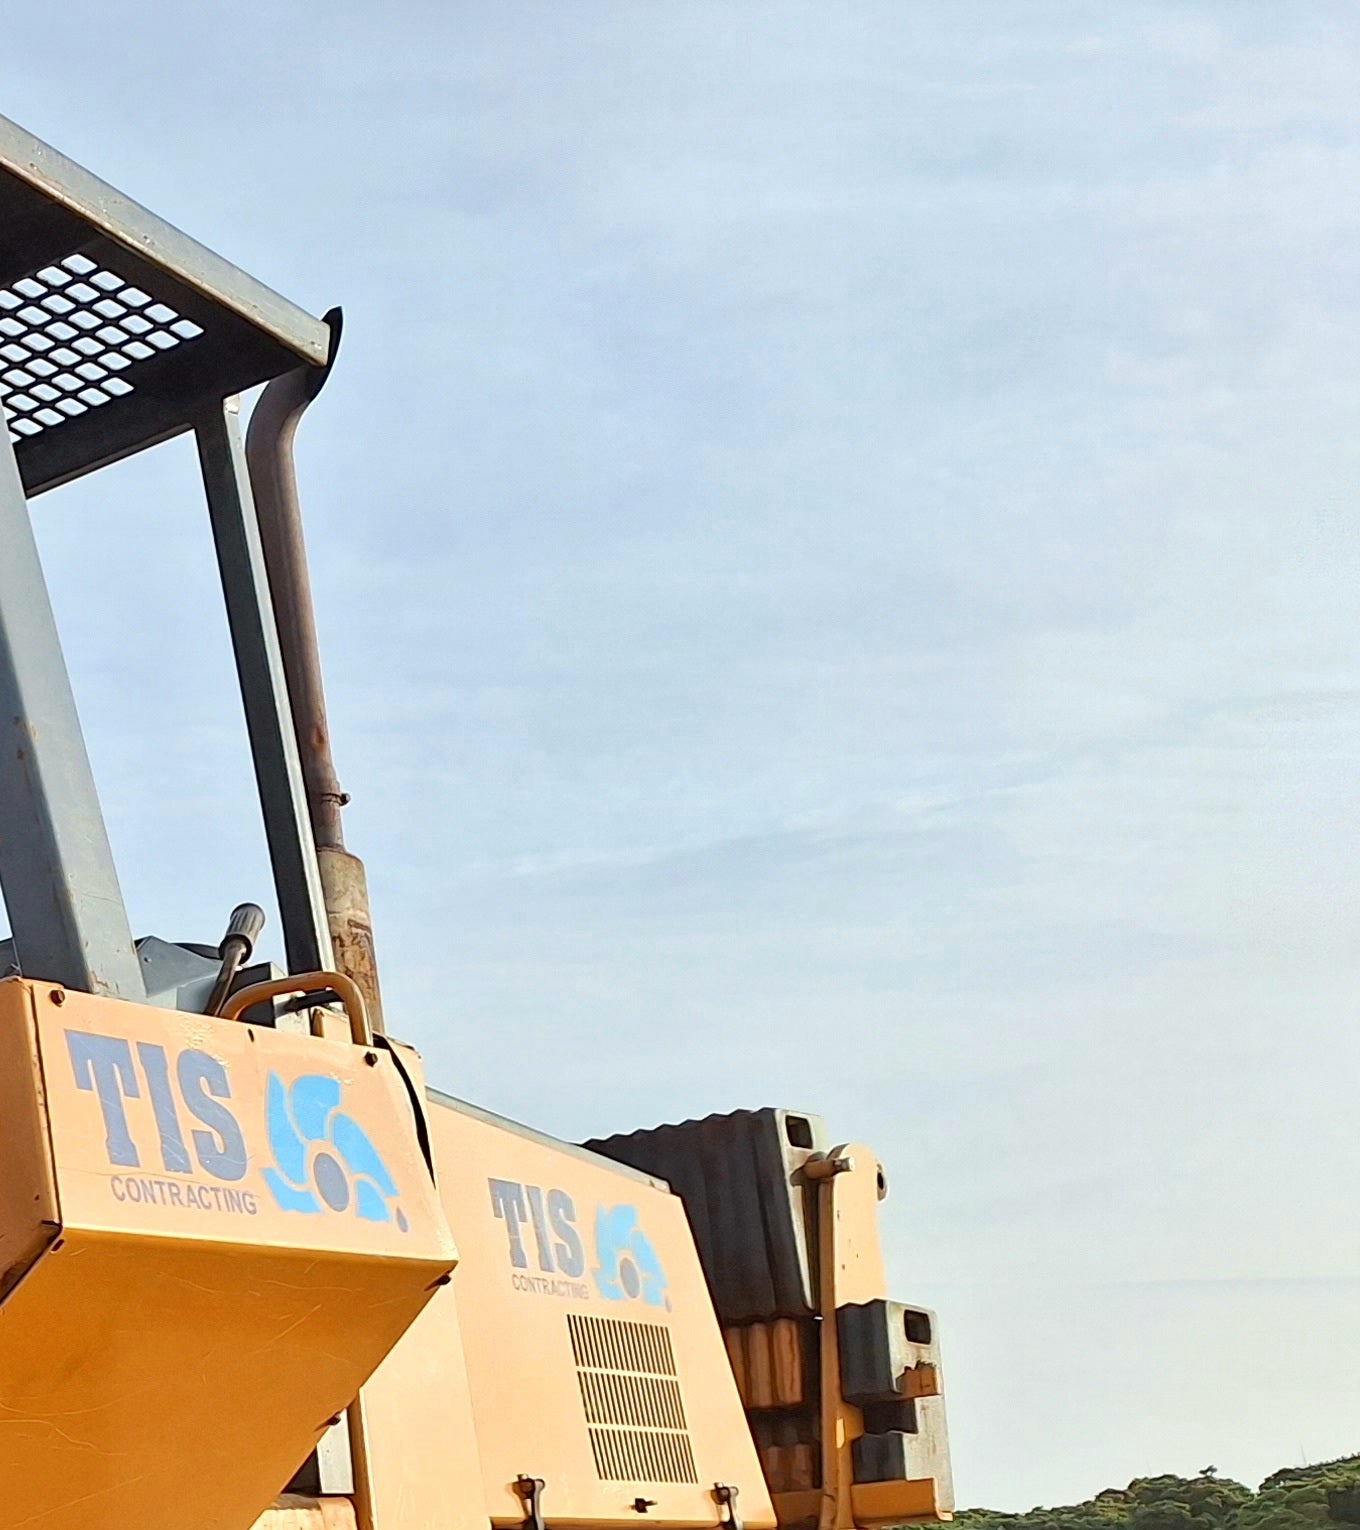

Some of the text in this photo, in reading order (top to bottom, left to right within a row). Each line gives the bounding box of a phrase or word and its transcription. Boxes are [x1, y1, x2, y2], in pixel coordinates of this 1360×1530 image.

[64, 1028, 248, 1182] TIS
[110, 1175, 258, 1215] CONTRACTING
[488, 1177, 585, 1278] TIS
[511, 1273, 590, 1300] CONTRACTING
